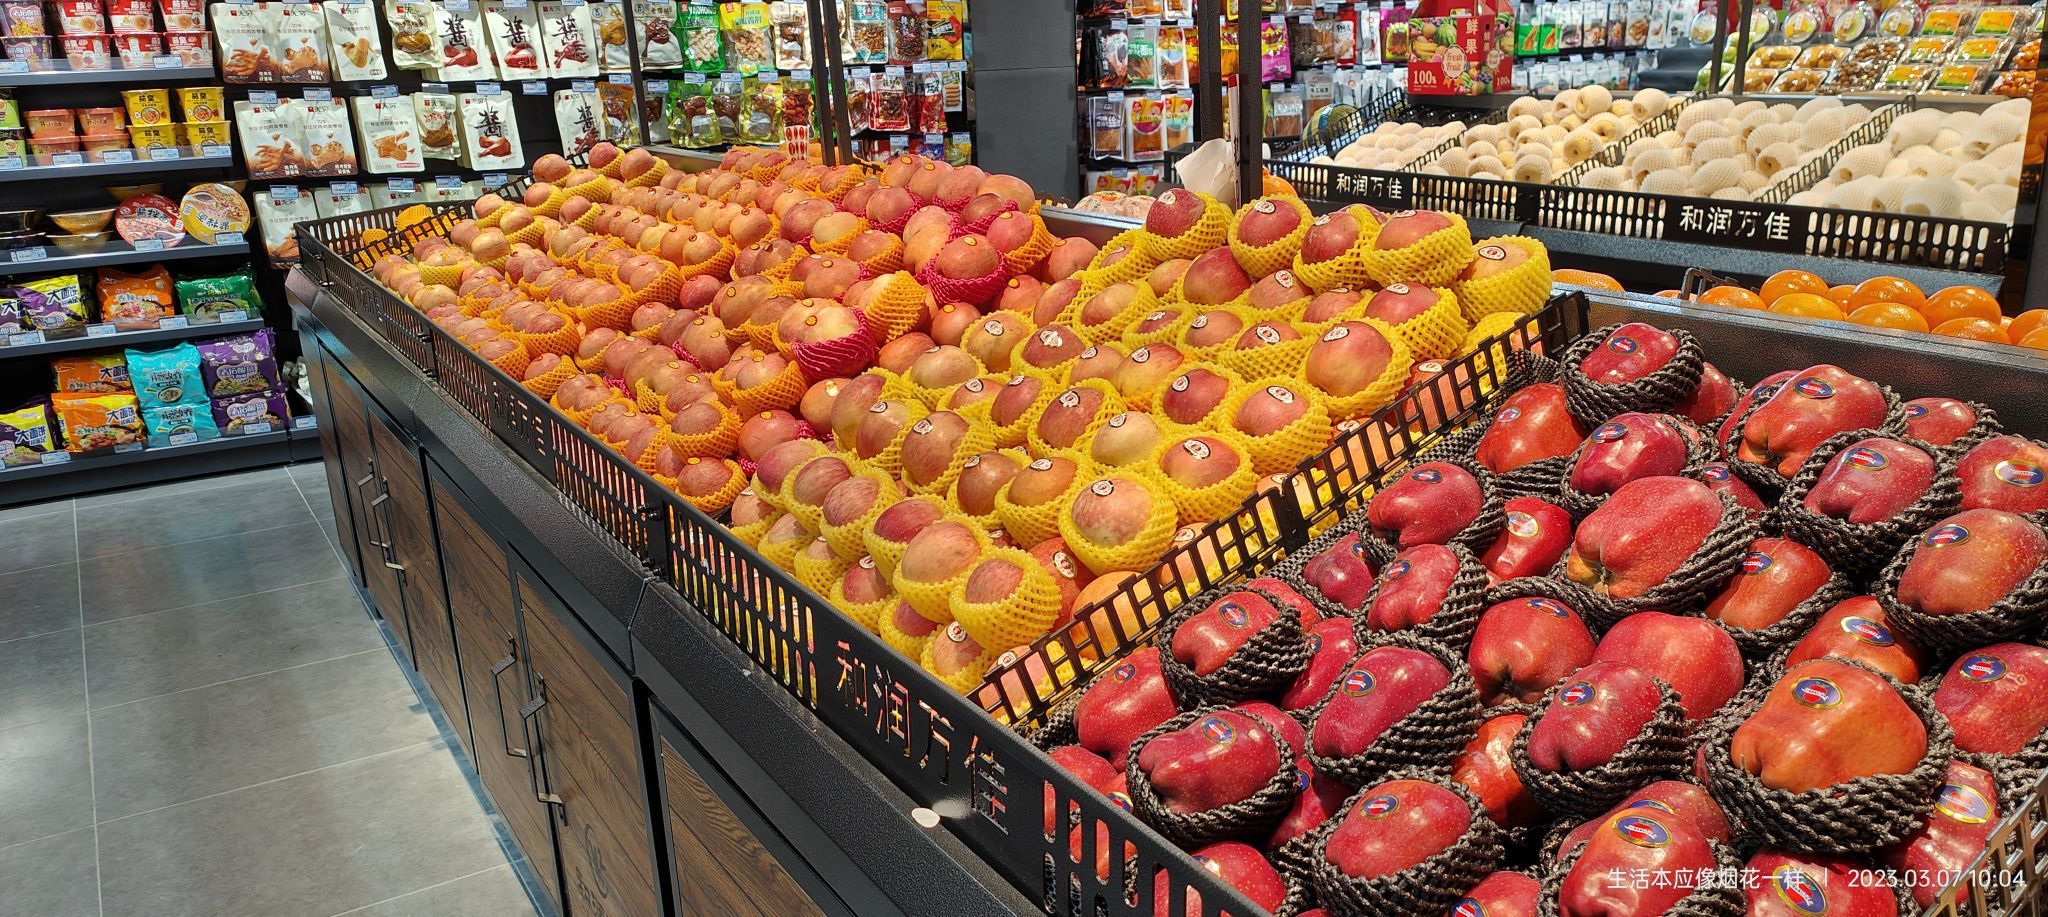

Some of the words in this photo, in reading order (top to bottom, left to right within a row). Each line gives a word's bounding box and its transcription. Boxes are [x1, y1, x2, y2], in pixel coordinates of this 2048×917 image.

[1335, 174, 1403, 200] 和润万佳
[1678, 205, 1791, 241] 和润万佳
[836, 639, 1009, 836] 和润万佳
